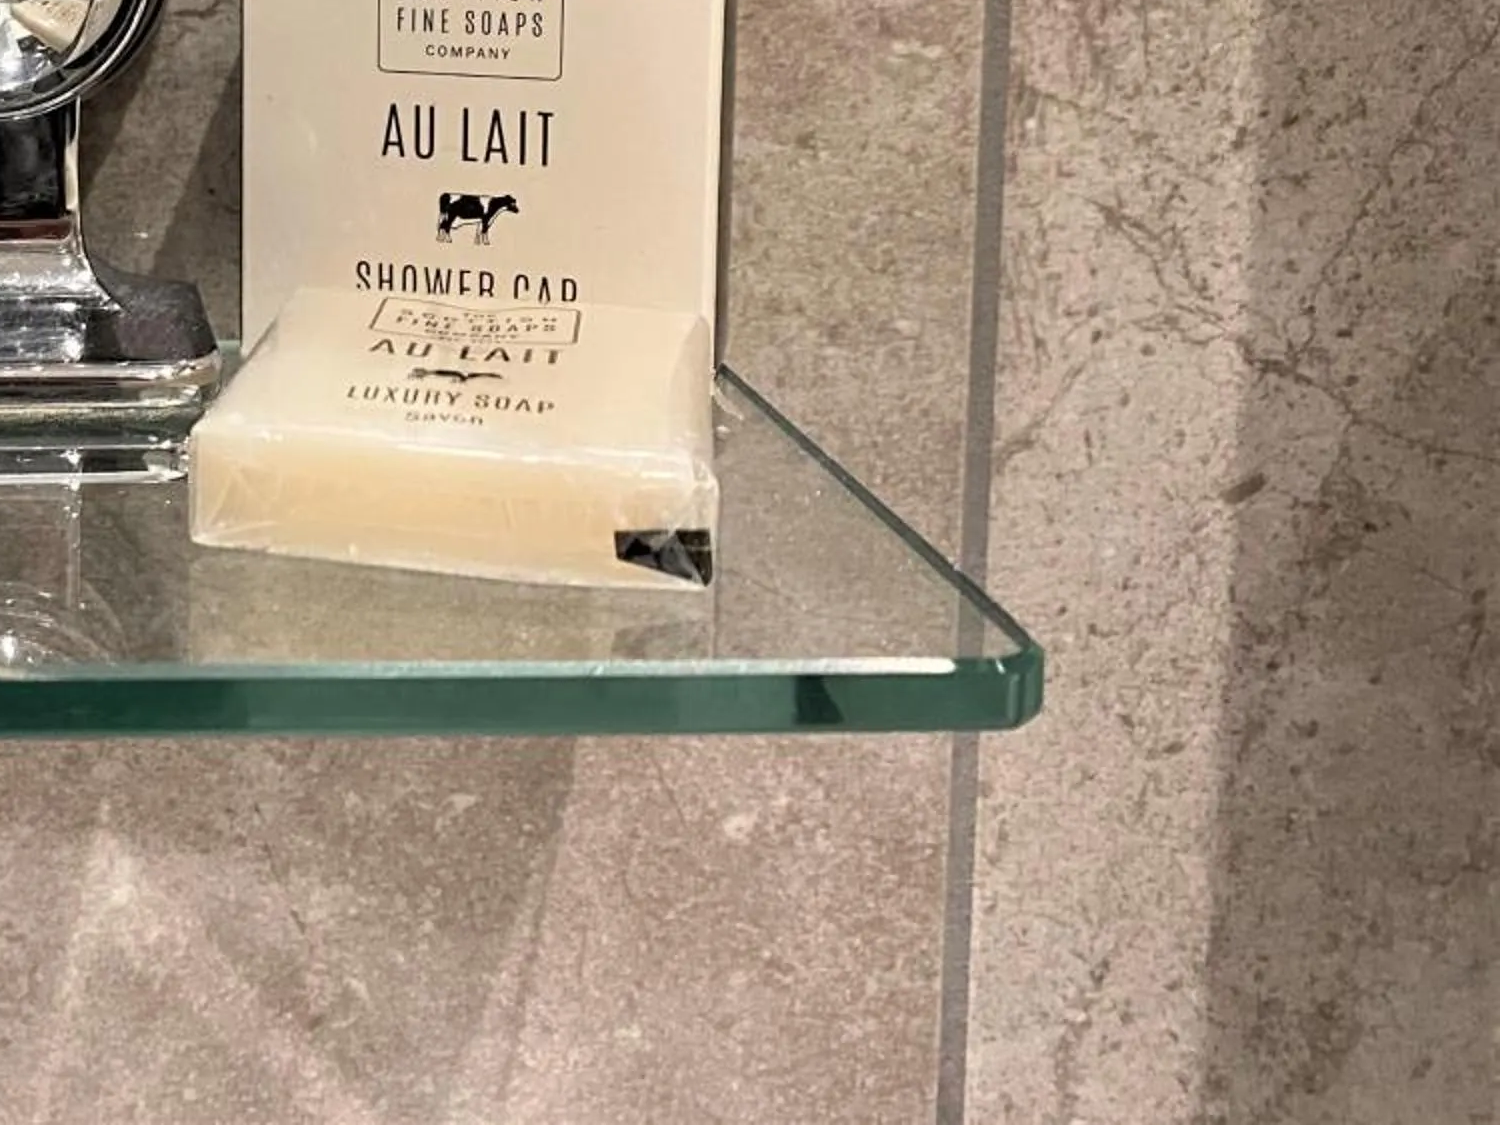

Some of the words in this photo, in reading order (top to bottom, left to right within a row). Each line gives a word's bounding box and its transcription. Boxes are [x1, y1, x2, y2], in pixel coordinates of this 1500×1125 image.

[397, 6, 450, 34] FINE
[465, 10, 543, 38] SOAPS
[425, 44, 511, 60] COMPANY
[382, 102, 436, 160] AU
[461, 107, 555, 168] LAIT
[356, 260, 496, 297] SHOWER
[369, 338, 432, 358] AU
[460, 345, 562, 365] LAIT
[347, 385, 463, 406] LUXURY
[474, 393, 555, 414] SOAP
